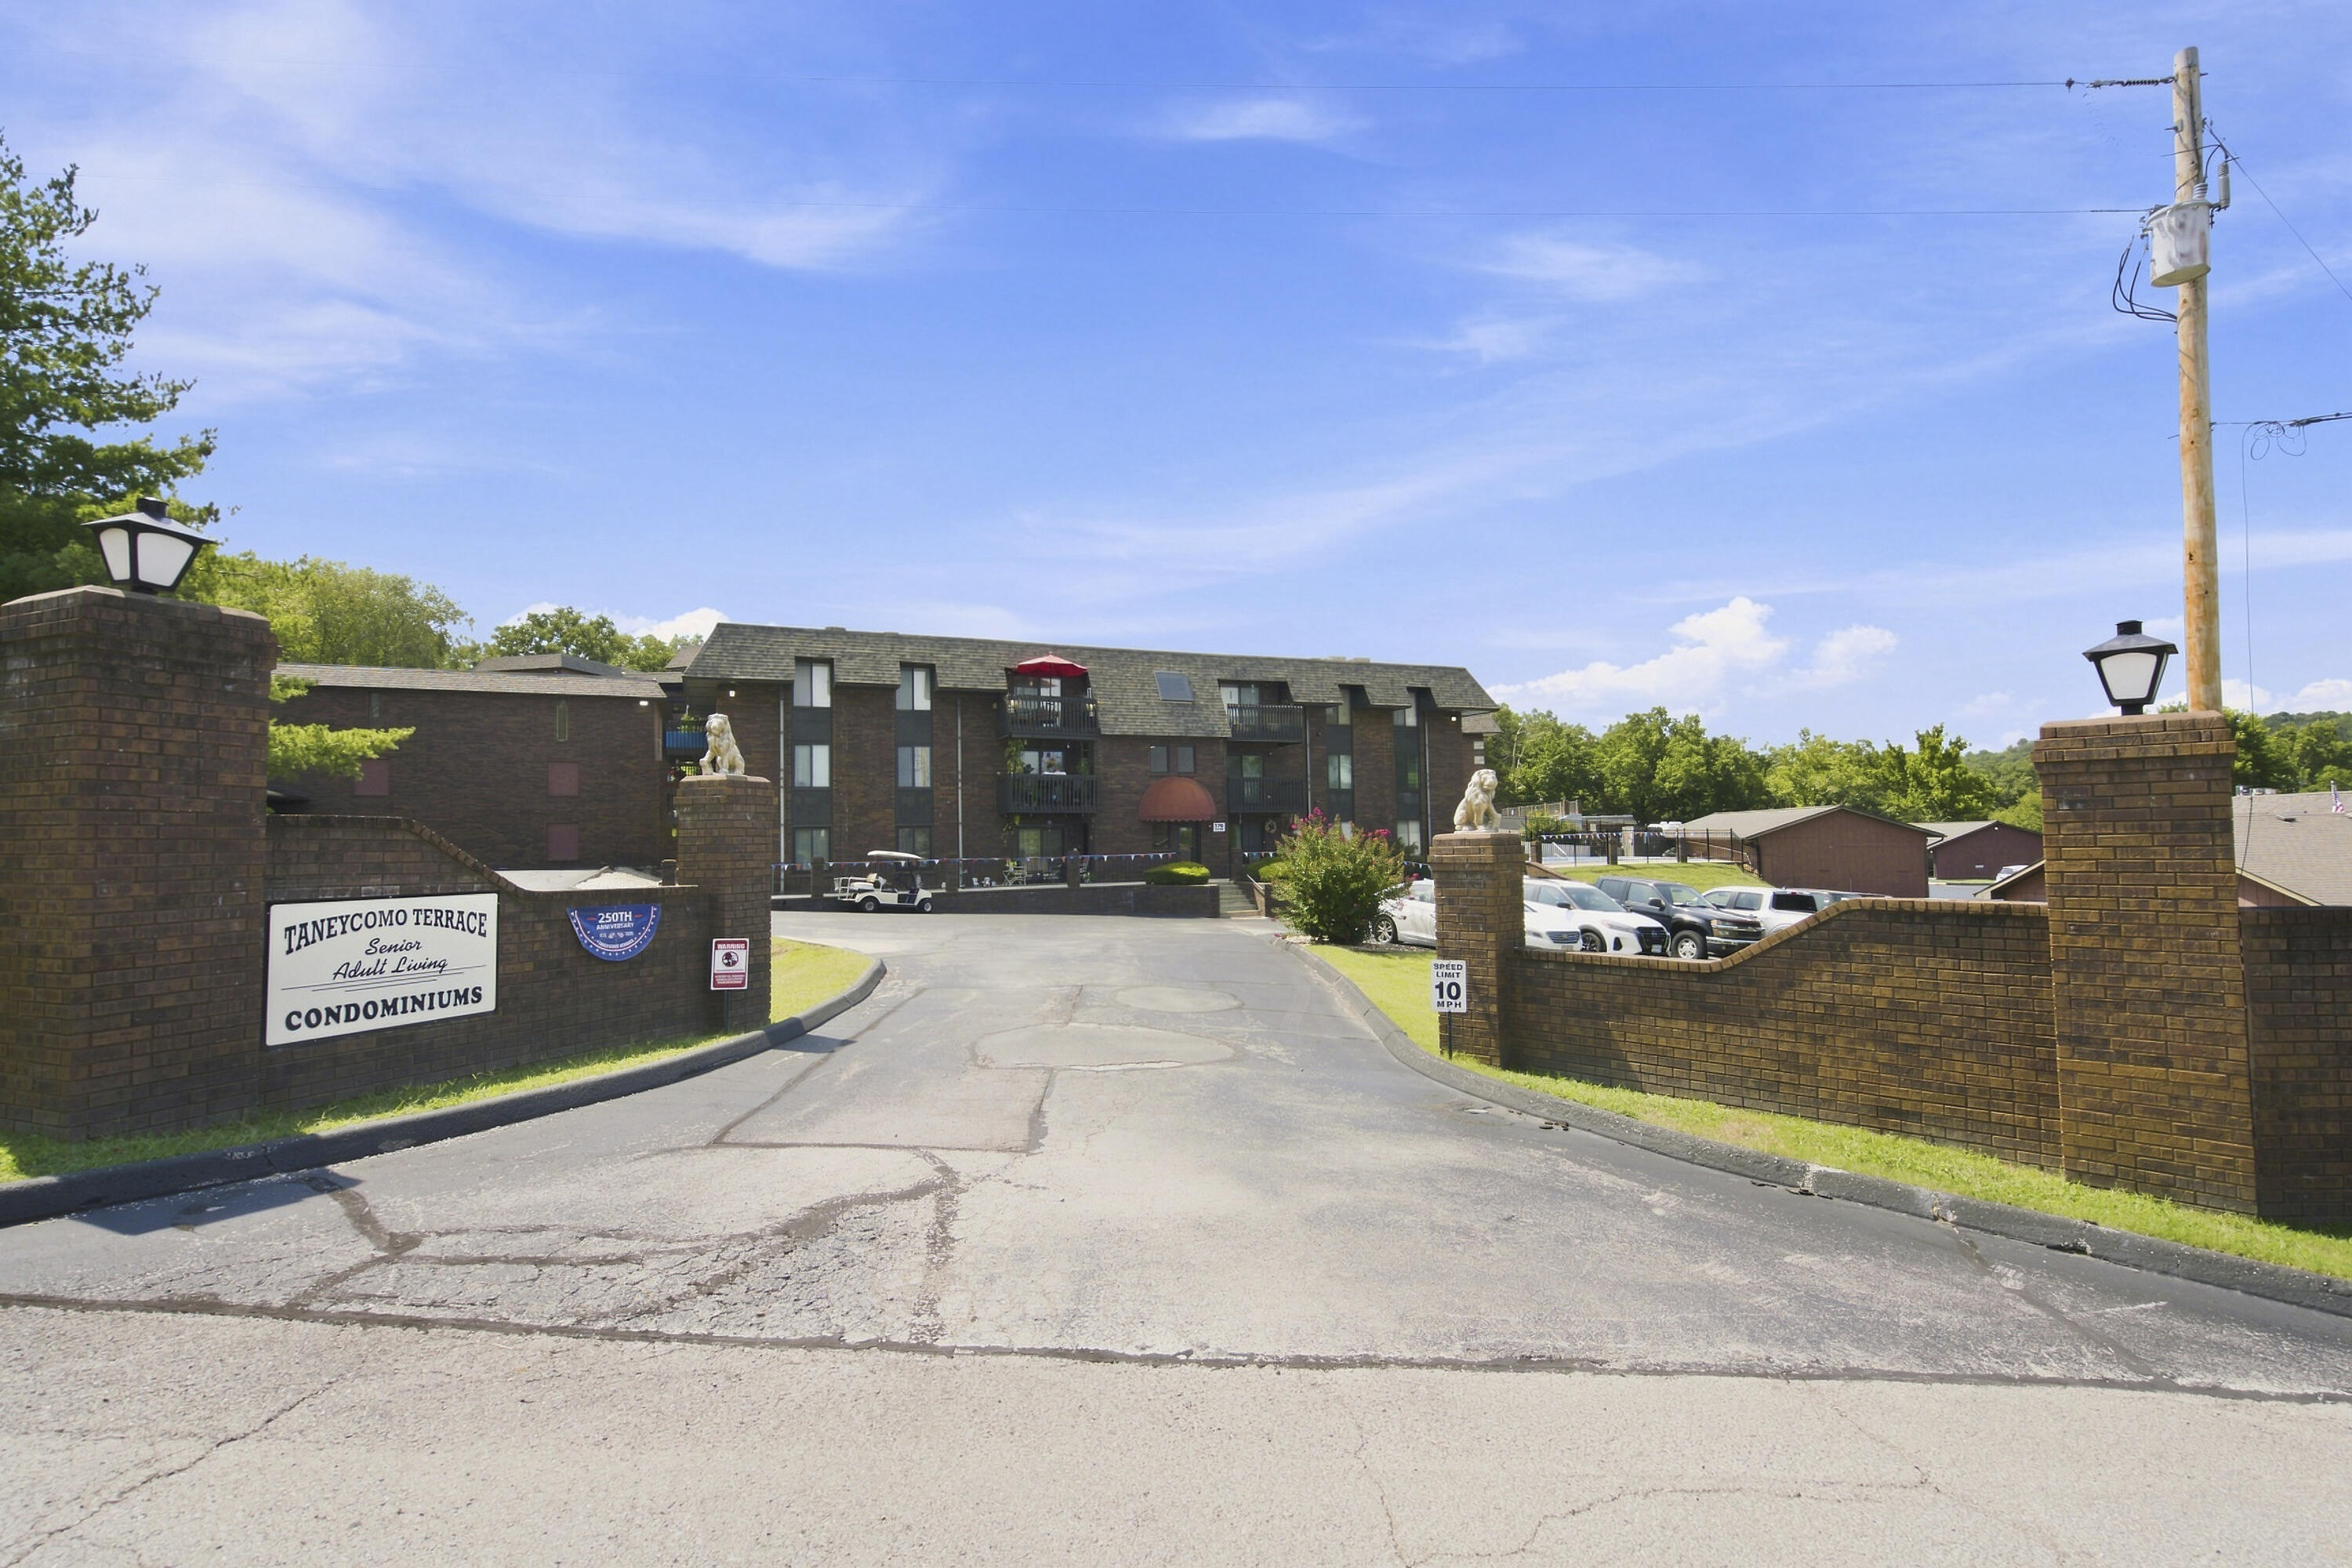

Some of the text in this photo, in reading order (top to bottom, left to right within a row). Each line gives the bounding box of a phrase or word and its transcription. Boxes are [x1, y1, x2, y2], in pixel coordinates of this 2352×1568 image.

[598, 911, 632, 924] 250TH
[285, 909, 487, 955] TANEYCOMO TERRACE
[365, 938, 422, 955] Senior
[332, 956, 448, 980] Adult Living
[1434, 981, 1461, 1000] 10
[285, 986, 483, 1031] CONDOMINIUMS
